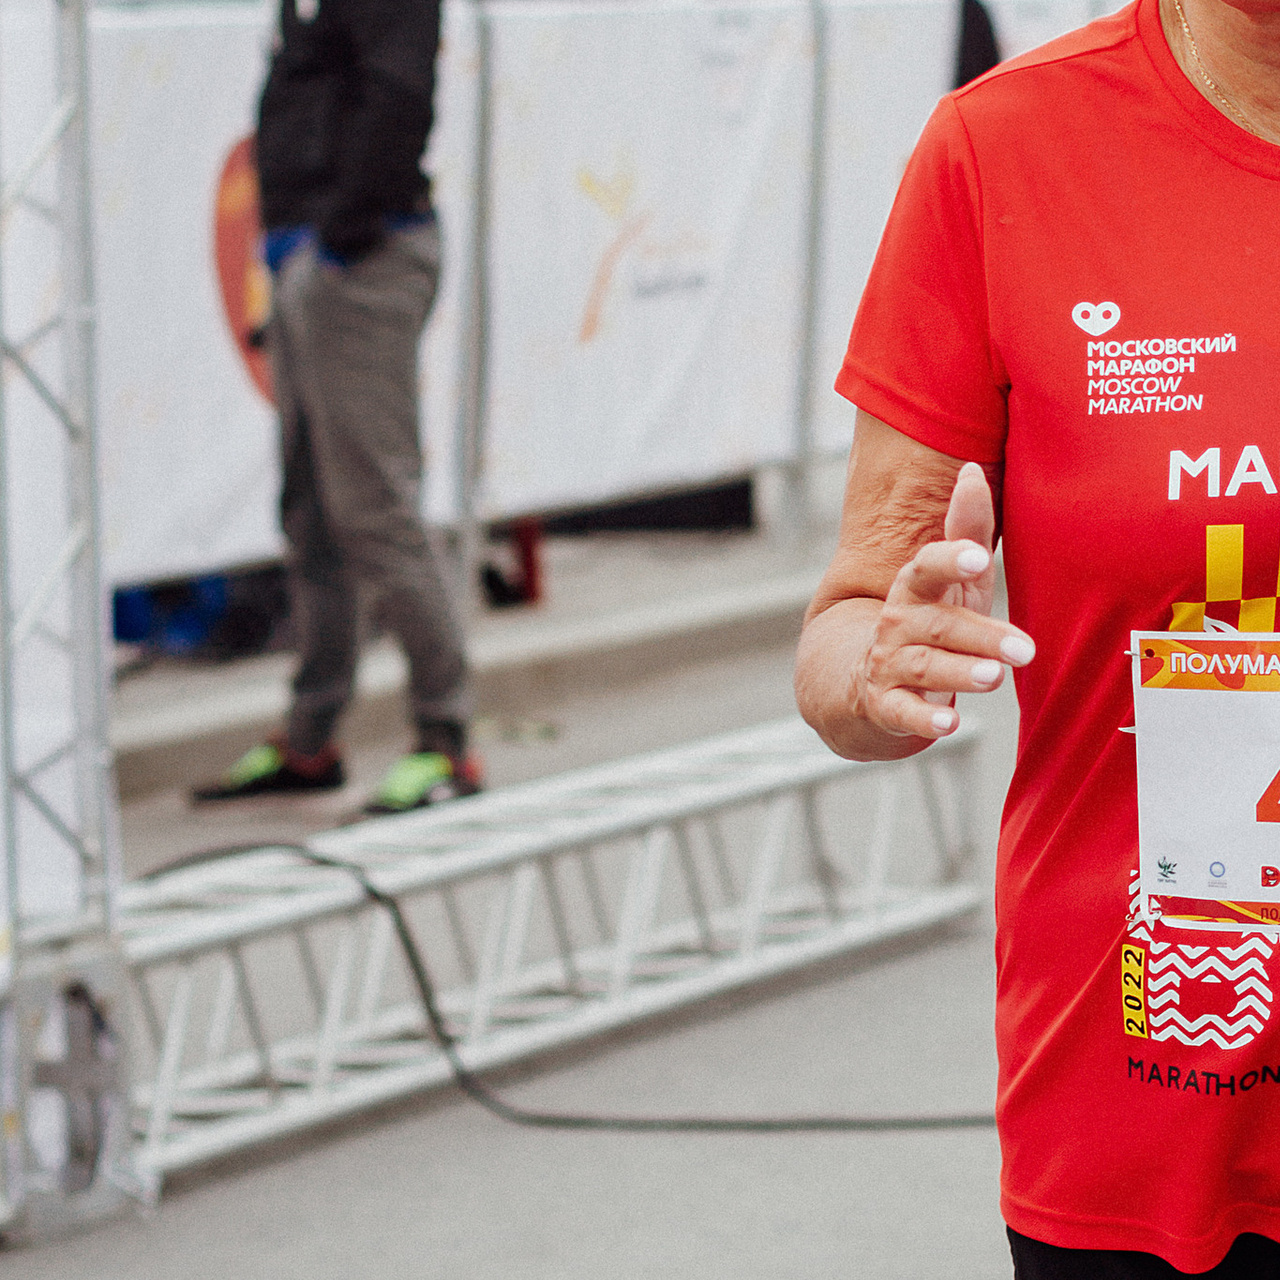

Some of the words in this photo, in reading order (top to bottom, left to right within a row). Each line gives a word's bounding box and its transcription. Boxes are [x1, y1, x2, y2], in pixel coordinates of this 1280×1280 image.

[1087, 333, 1237, 357] МОСКОВСКИЙ
[1087, 357, 1195, 376] МАРАФОН
[1087, 376, 1182, 396] MOSCOW
[1088, 394, 1204, 415] MARATHON
[1124, 948, 1146, 1036] 2022
